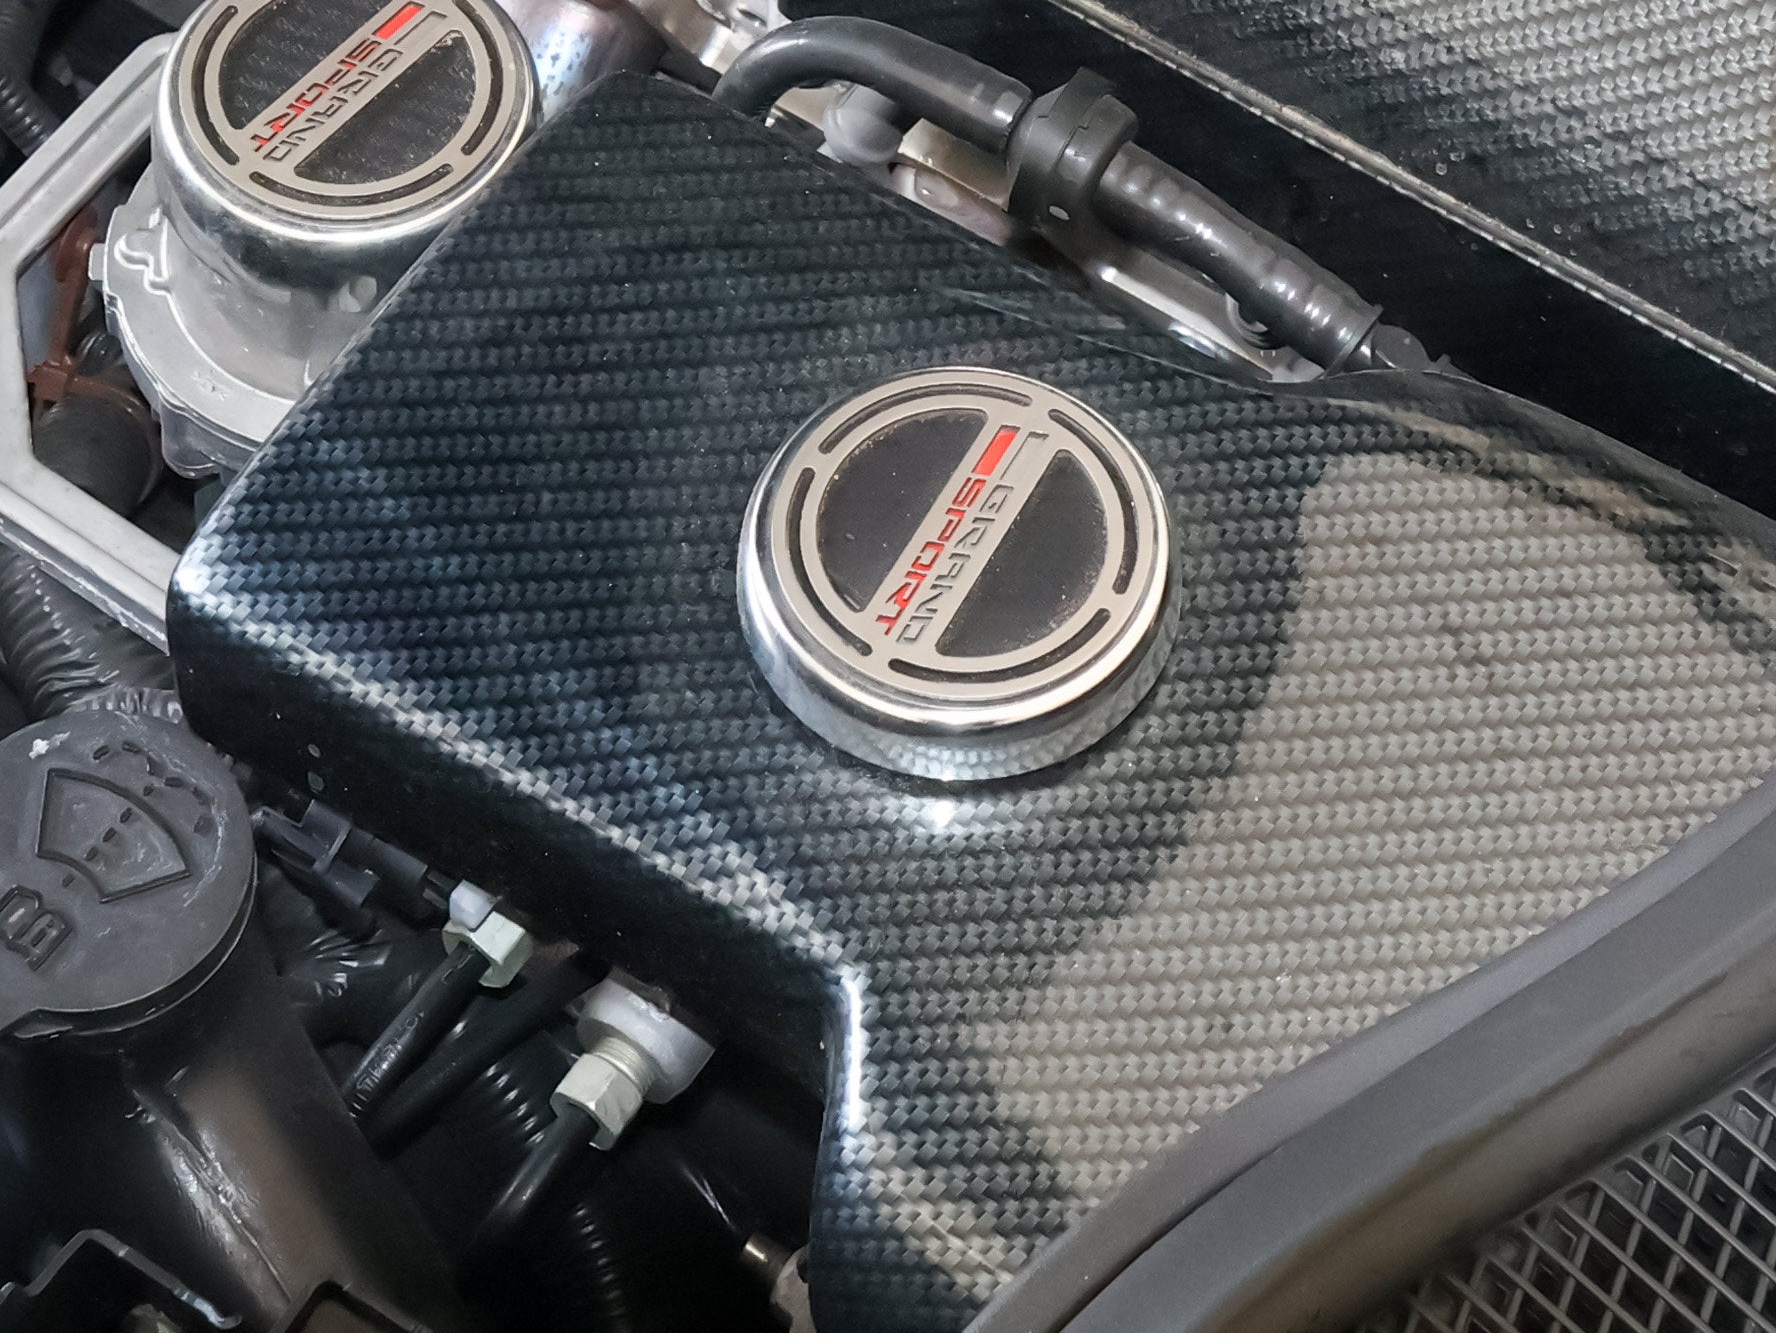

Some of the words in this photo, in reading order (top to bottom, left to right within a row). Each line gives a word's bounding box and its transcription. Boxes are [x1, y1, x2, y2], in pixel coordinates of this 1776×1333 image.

[250, 37, 383, 153] SPORT
[263, 48, 405, 162] GRAND
[875, 476, 987, 637] SPORT
[895, 484, 1015, 645] GRAND
